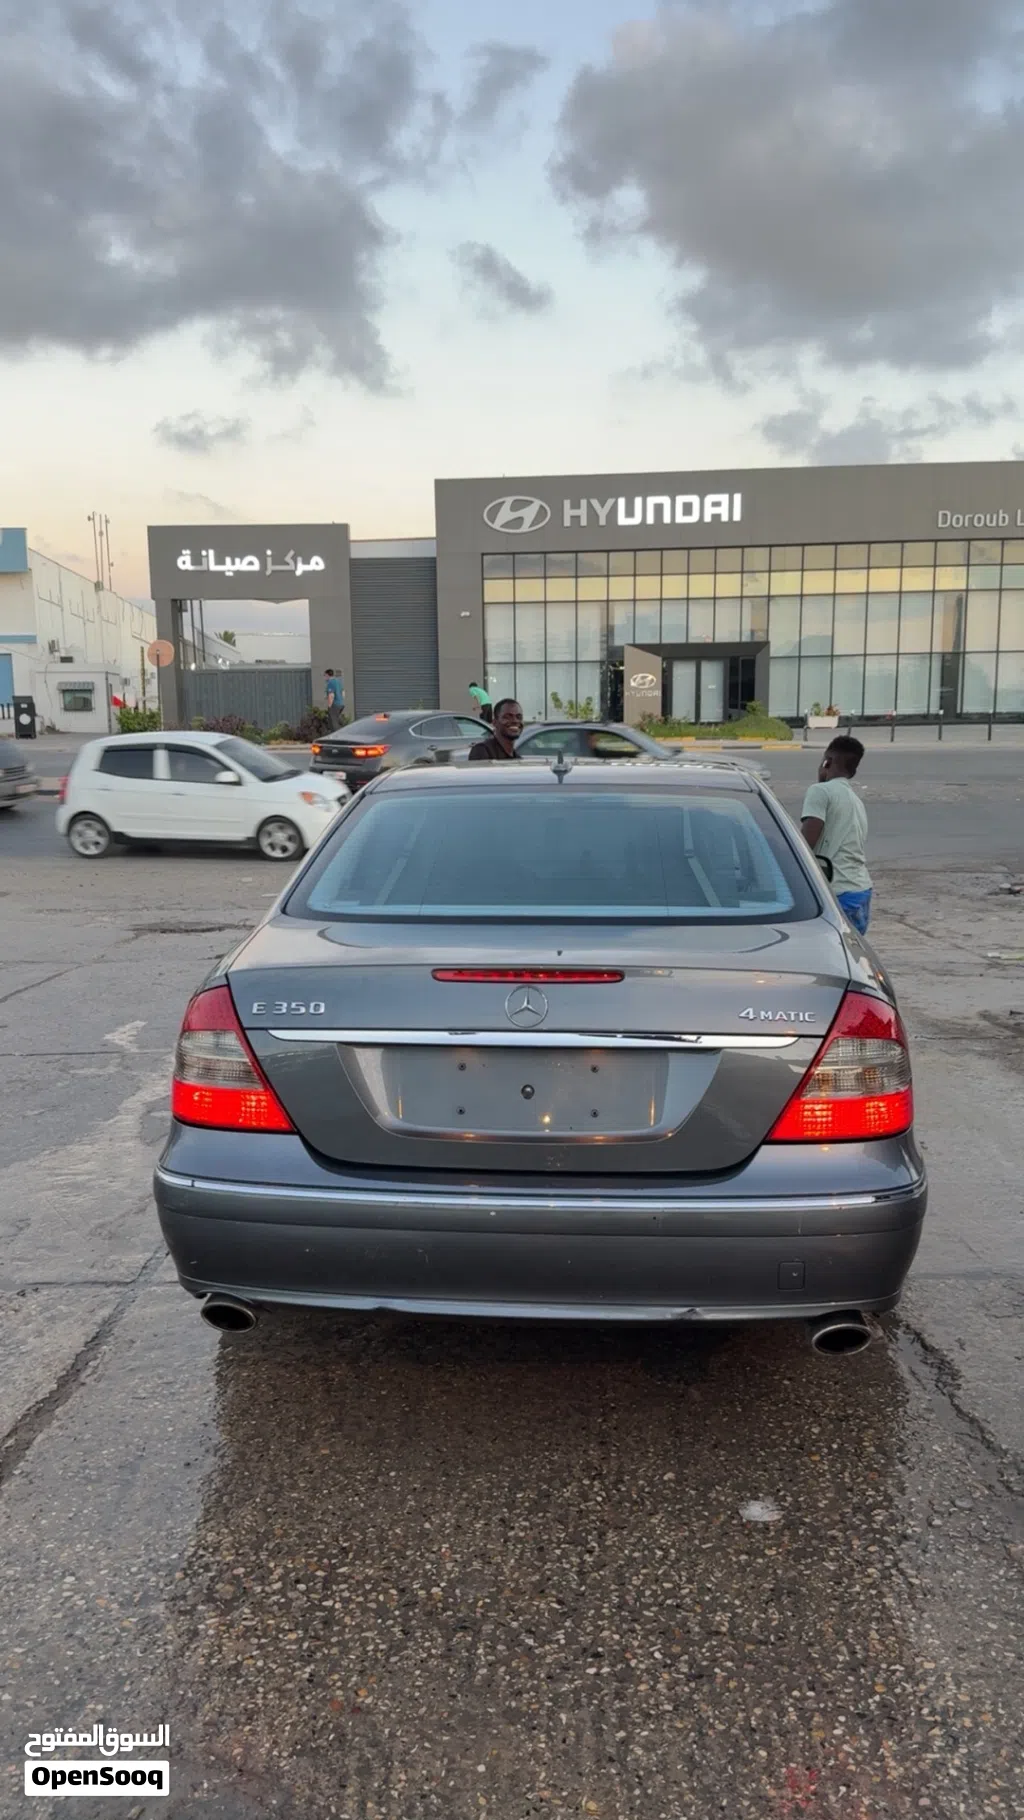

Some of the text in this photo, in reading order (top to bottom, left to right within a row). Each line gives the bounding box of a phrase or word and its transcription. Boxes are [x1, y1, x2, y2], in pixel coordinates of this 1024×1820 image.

[563, 492, 742, 527] HYUNDAI
[937, 508, 1009, 528] Doroub
[176, 549, 325, 576] مركز صيانة
[252, 1001, 325, 1015] E 350
